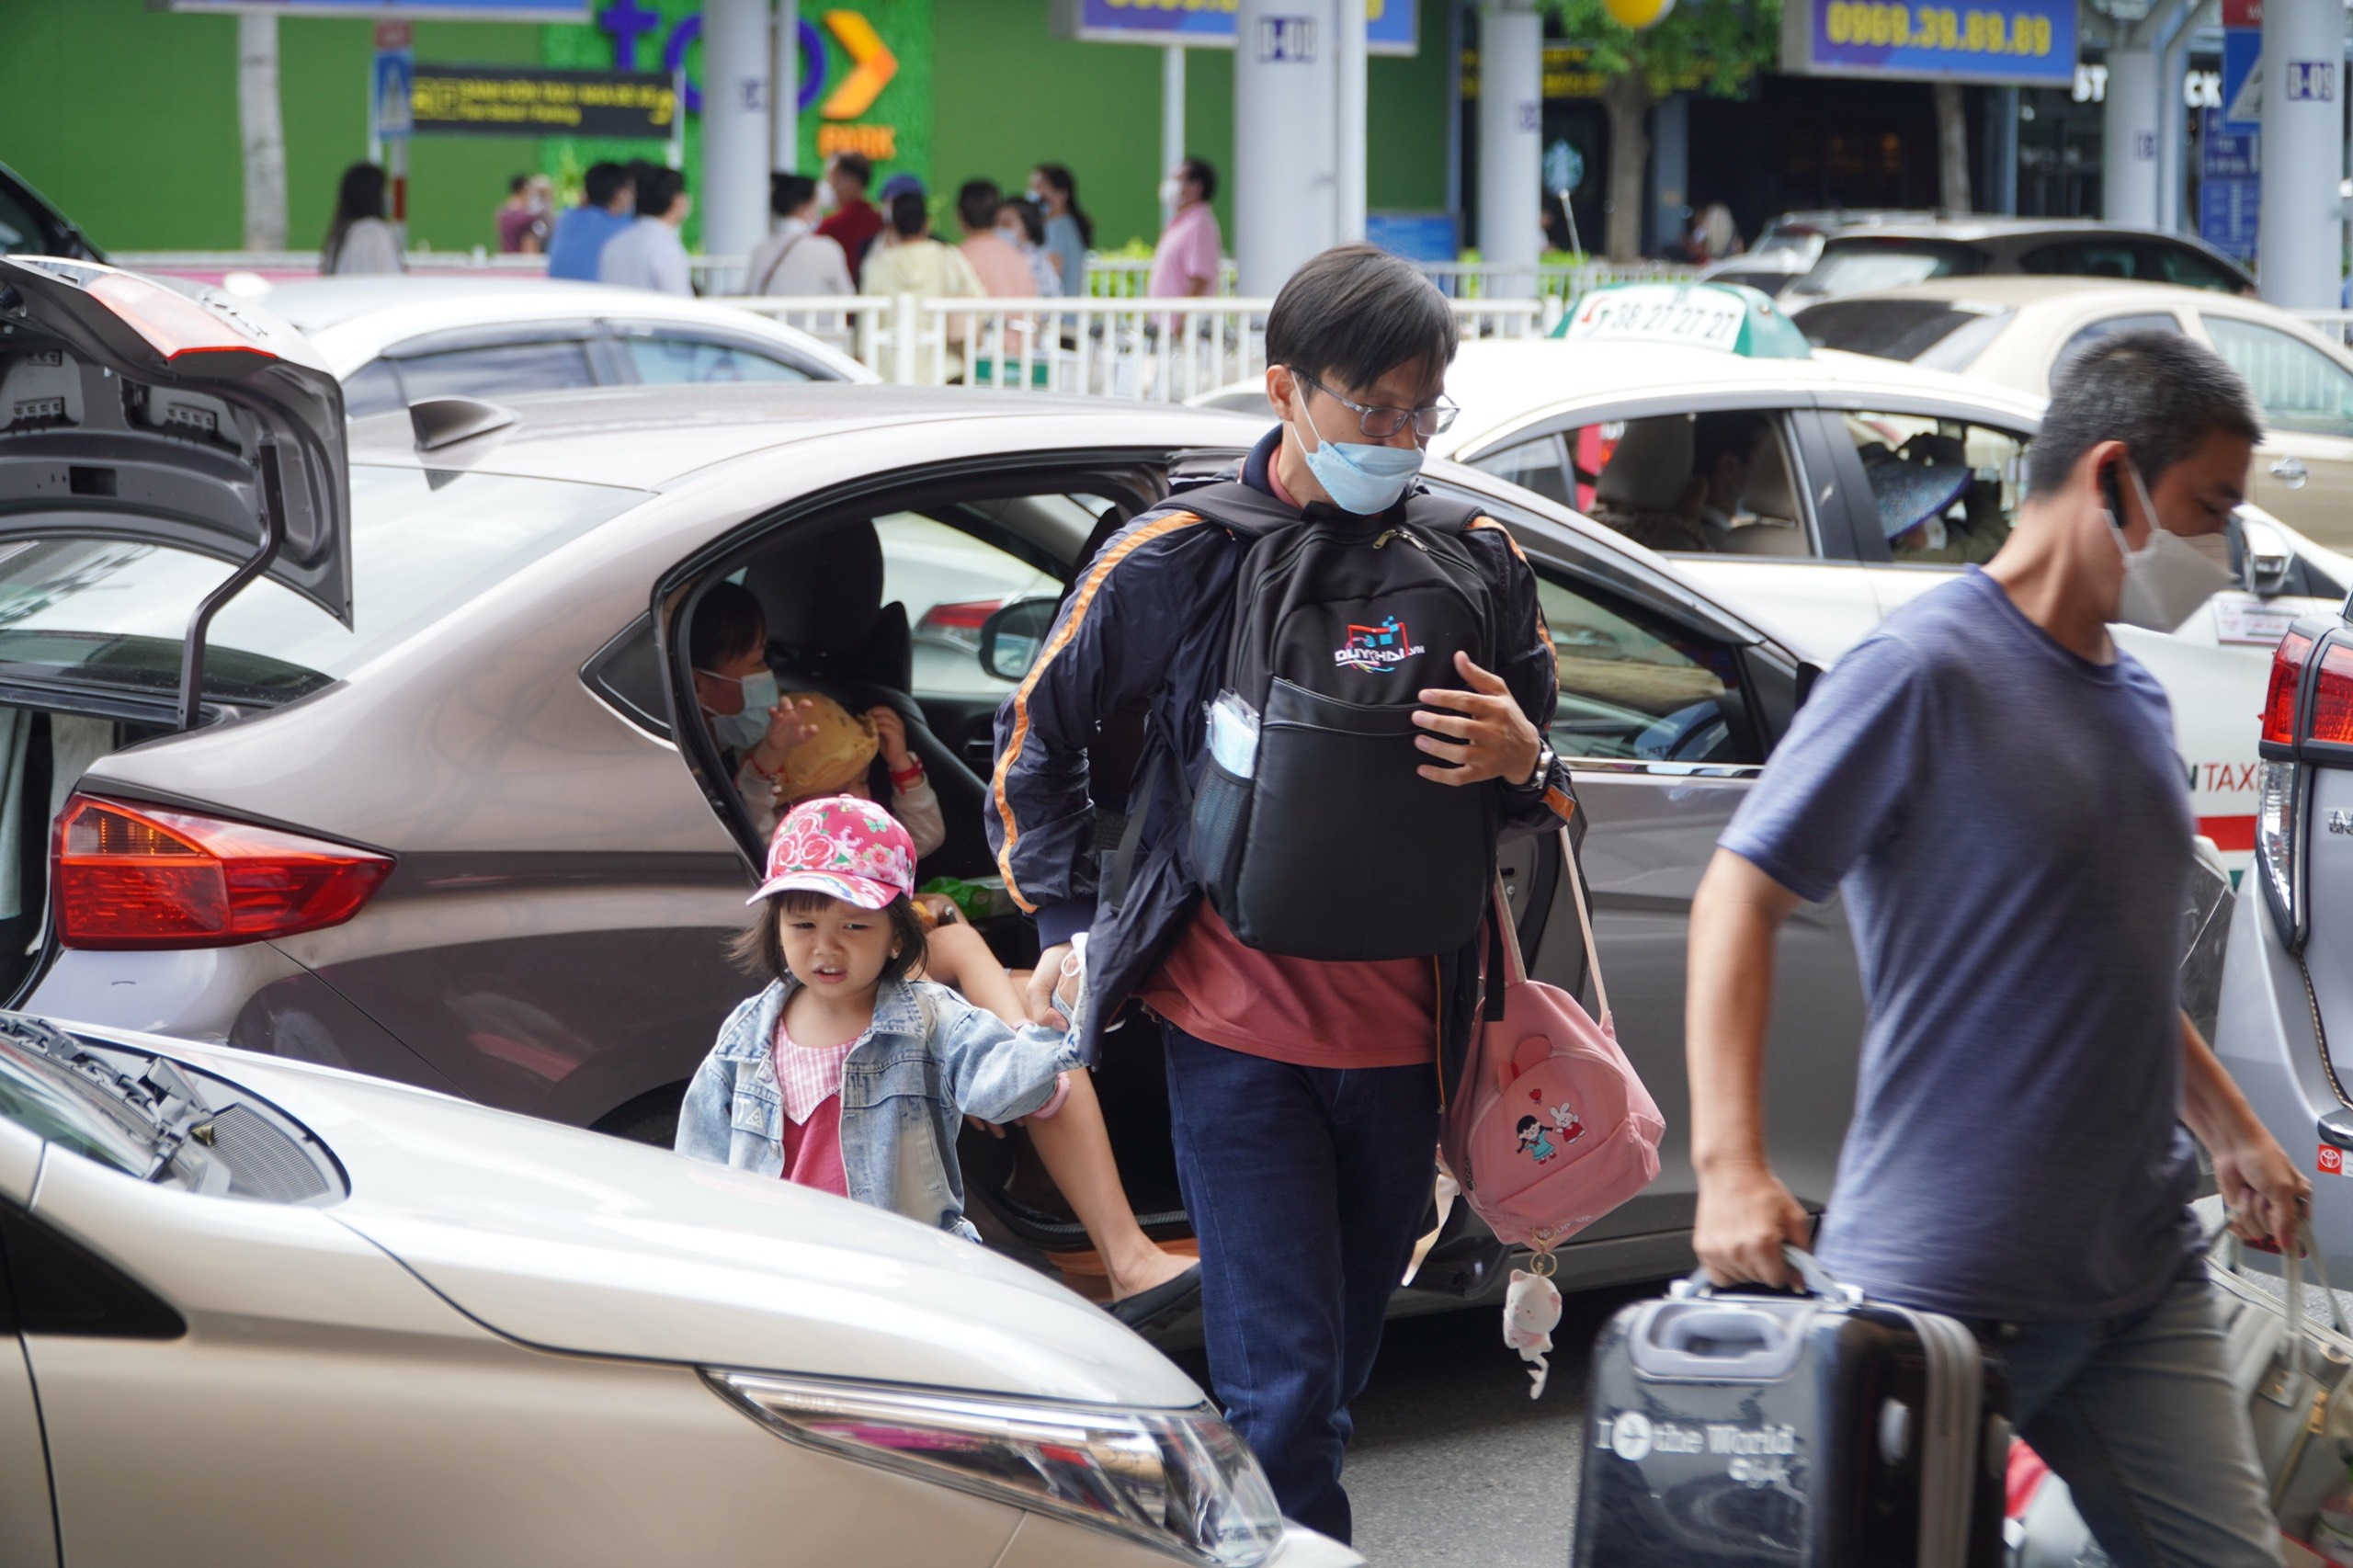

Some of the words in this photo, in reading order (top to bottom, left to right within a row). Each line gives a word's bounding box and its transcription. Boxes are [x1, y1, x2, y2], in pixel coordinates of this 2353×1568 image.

[1672, 308, 1706, 336] 27
[1704, 312, 1737, 343] 27
[1653, 1423, 1704, 1454] the
[1706, 1425, 1795, 1454] World
